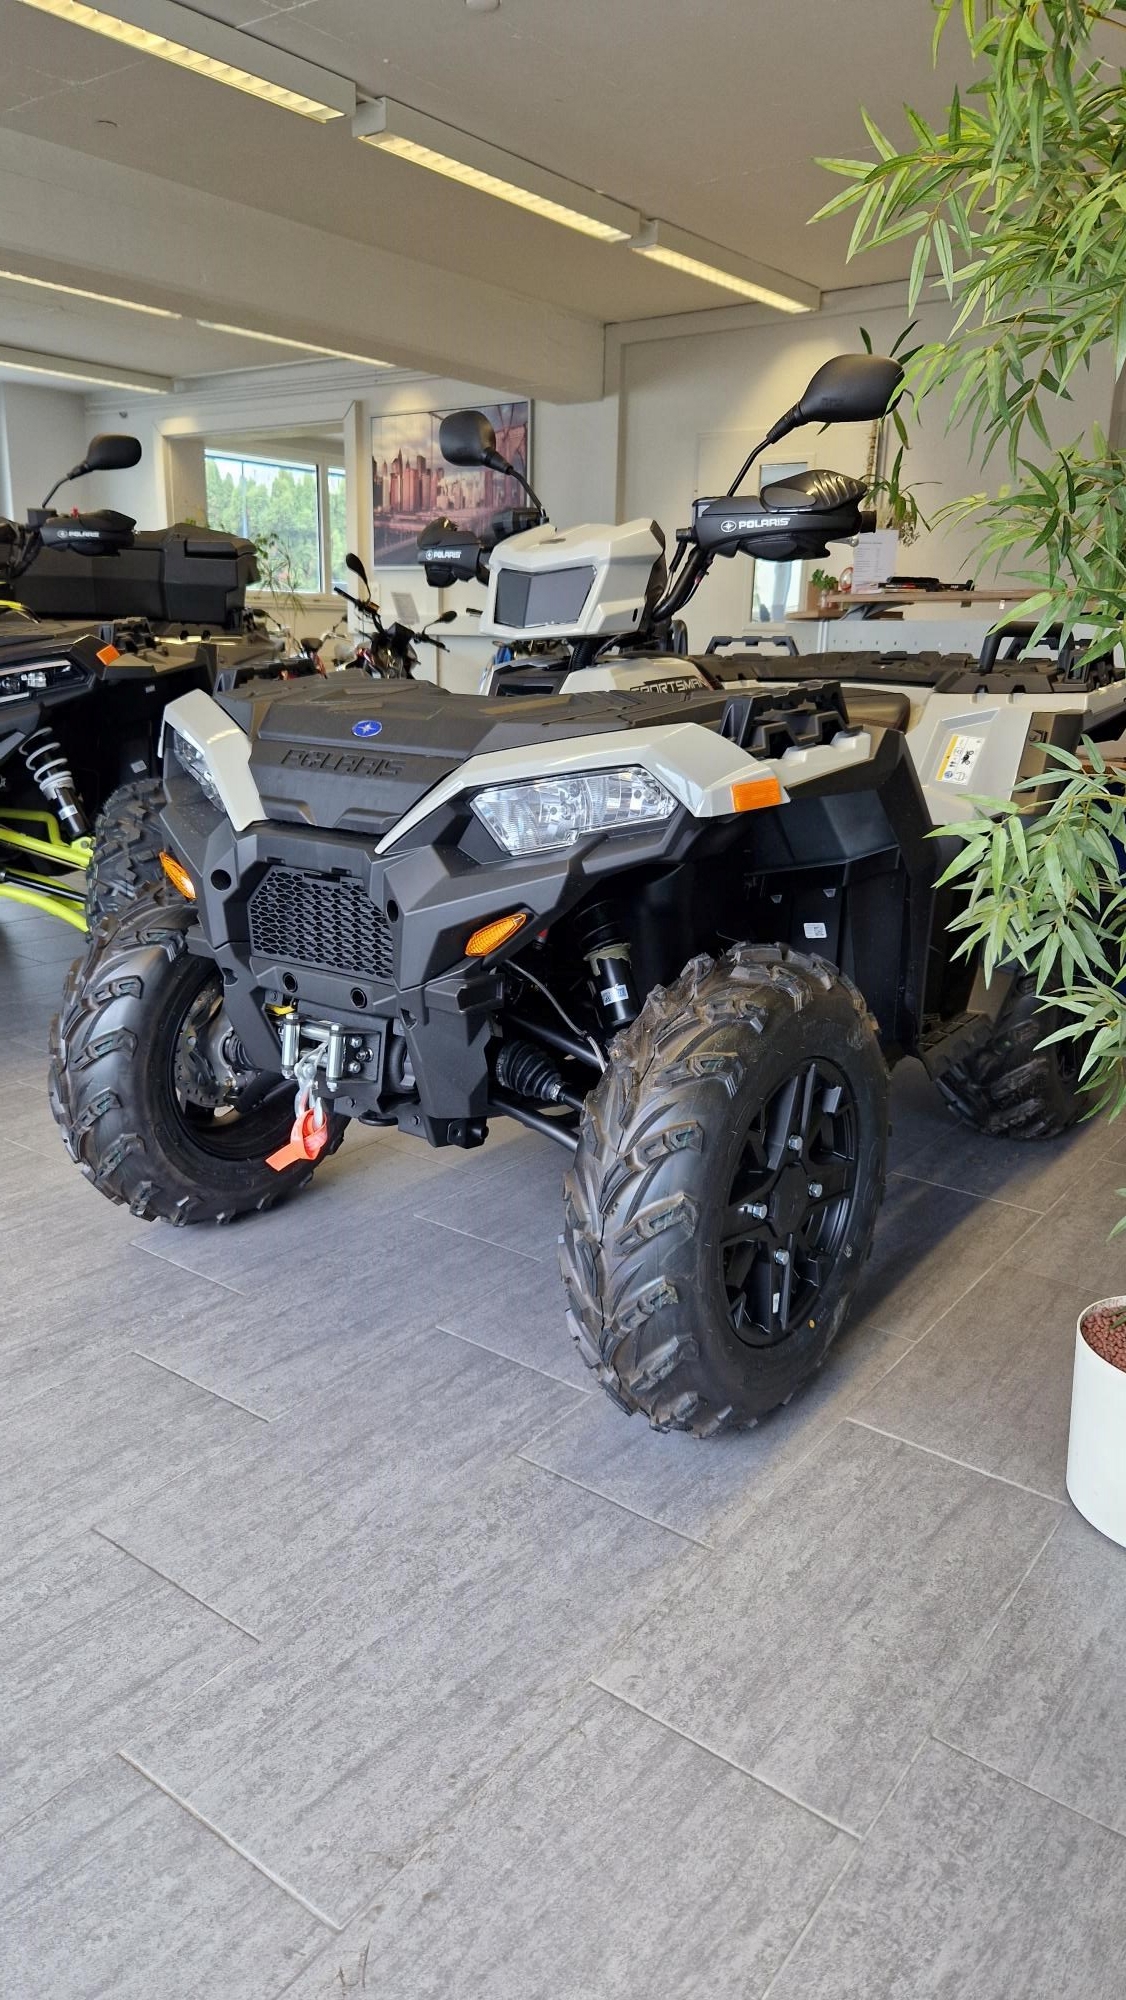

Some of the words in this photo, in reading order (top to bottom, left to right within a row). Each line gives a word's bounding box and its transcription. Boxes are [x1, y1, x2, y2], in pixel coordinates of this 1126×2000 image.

[738, 518, 791, 529] POLARIS
[433, 551, 462, 559] POLARIS
[281, 749, 406, 776] POLARIS
